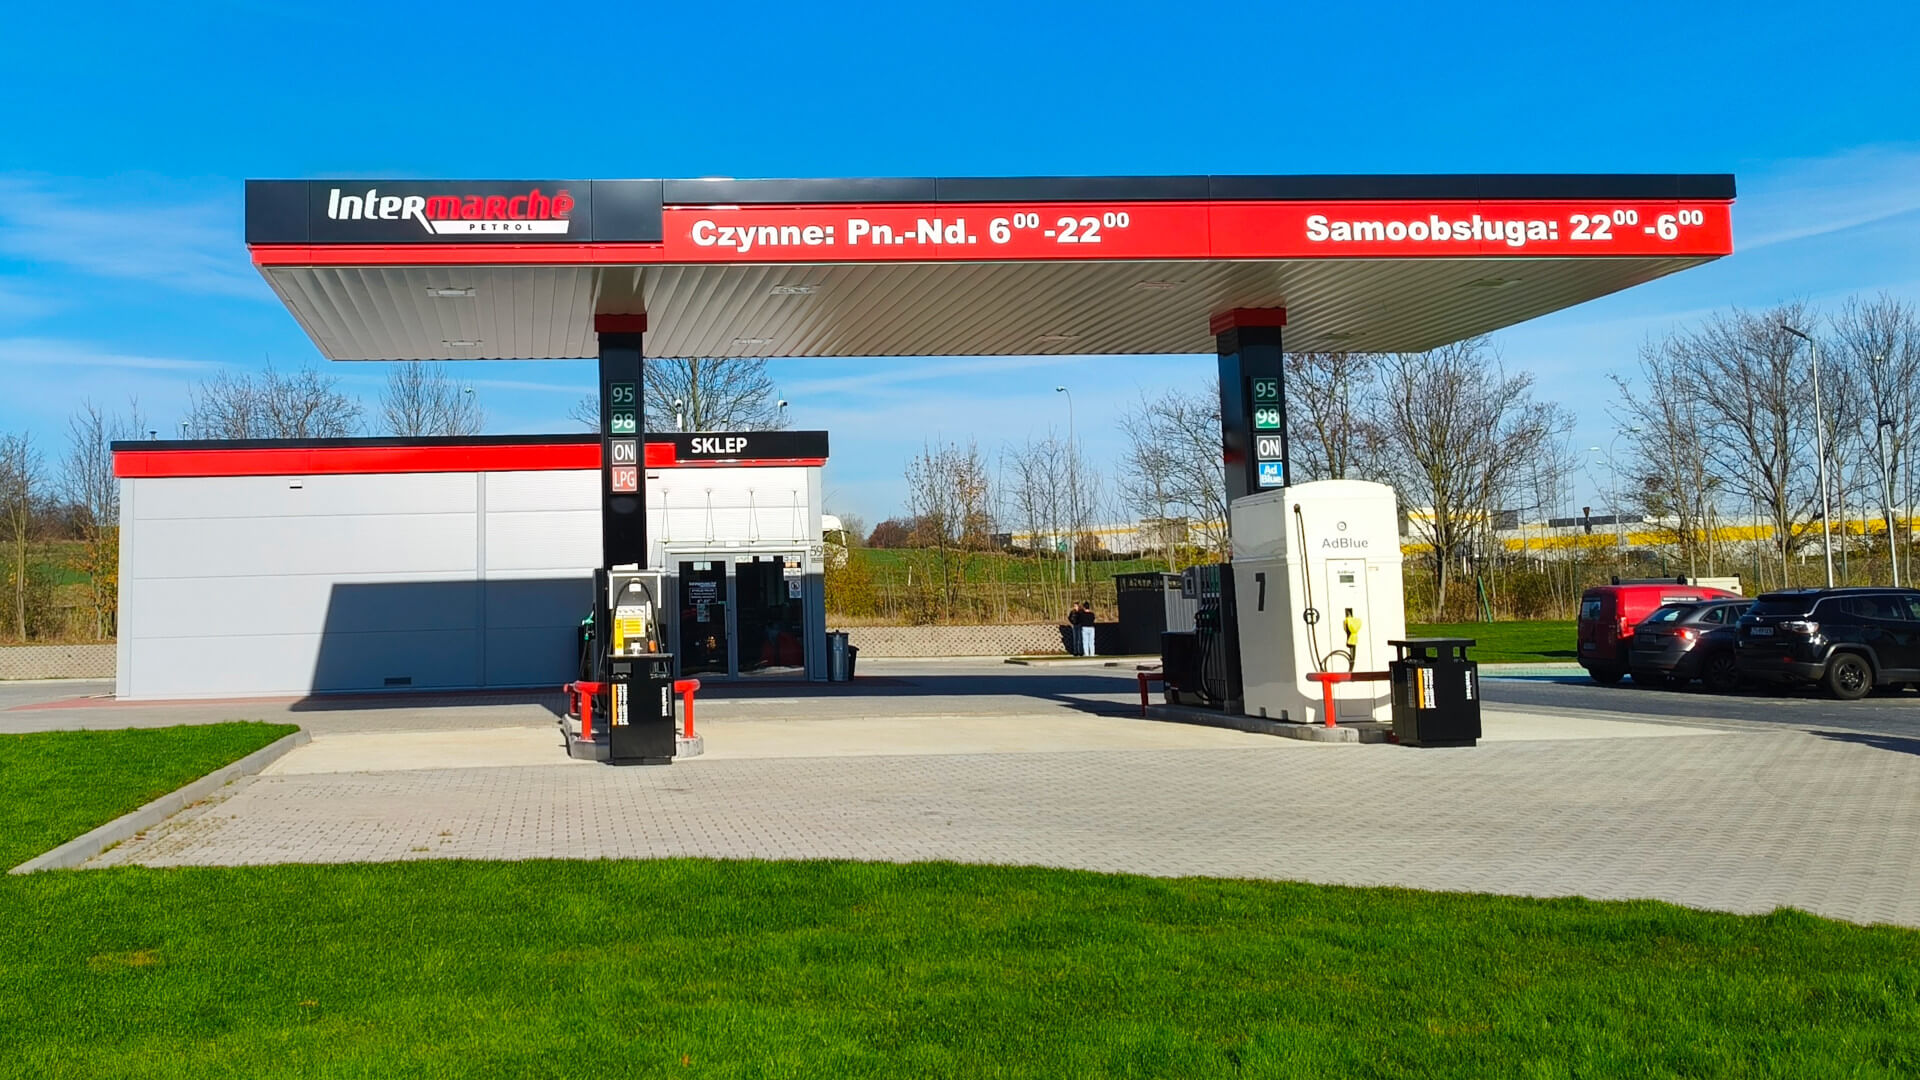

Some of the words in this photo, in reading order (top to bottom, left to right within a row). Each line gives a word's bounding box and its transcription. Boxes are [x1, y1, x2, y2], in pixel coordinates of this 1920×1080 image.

[469, 223, 535, 232] PETROL
[691, 219, 835, 252] Czynne:
[848, 218, 977, 246] Pn.-Nd.
[1306, 215, 1560, 248] Samoobsługa:
[612, 387, 634, 403] 95
[1255, 382, 1277, 398] 95
[612, 413, 635, 429] 98
[1257, 408, 1279, 425] 98
[614, 444, 634, 461] ON
[691, 437, 748, 454] SKLEP
[1259, 439, 1280, 456] ON
[1264, 464, 1278, 475] Ad
[613, 471, 636, 488] LPG
[1260, 474, 1282, 484] Blue
[1321, 537, 1369, 549] AdBlue
